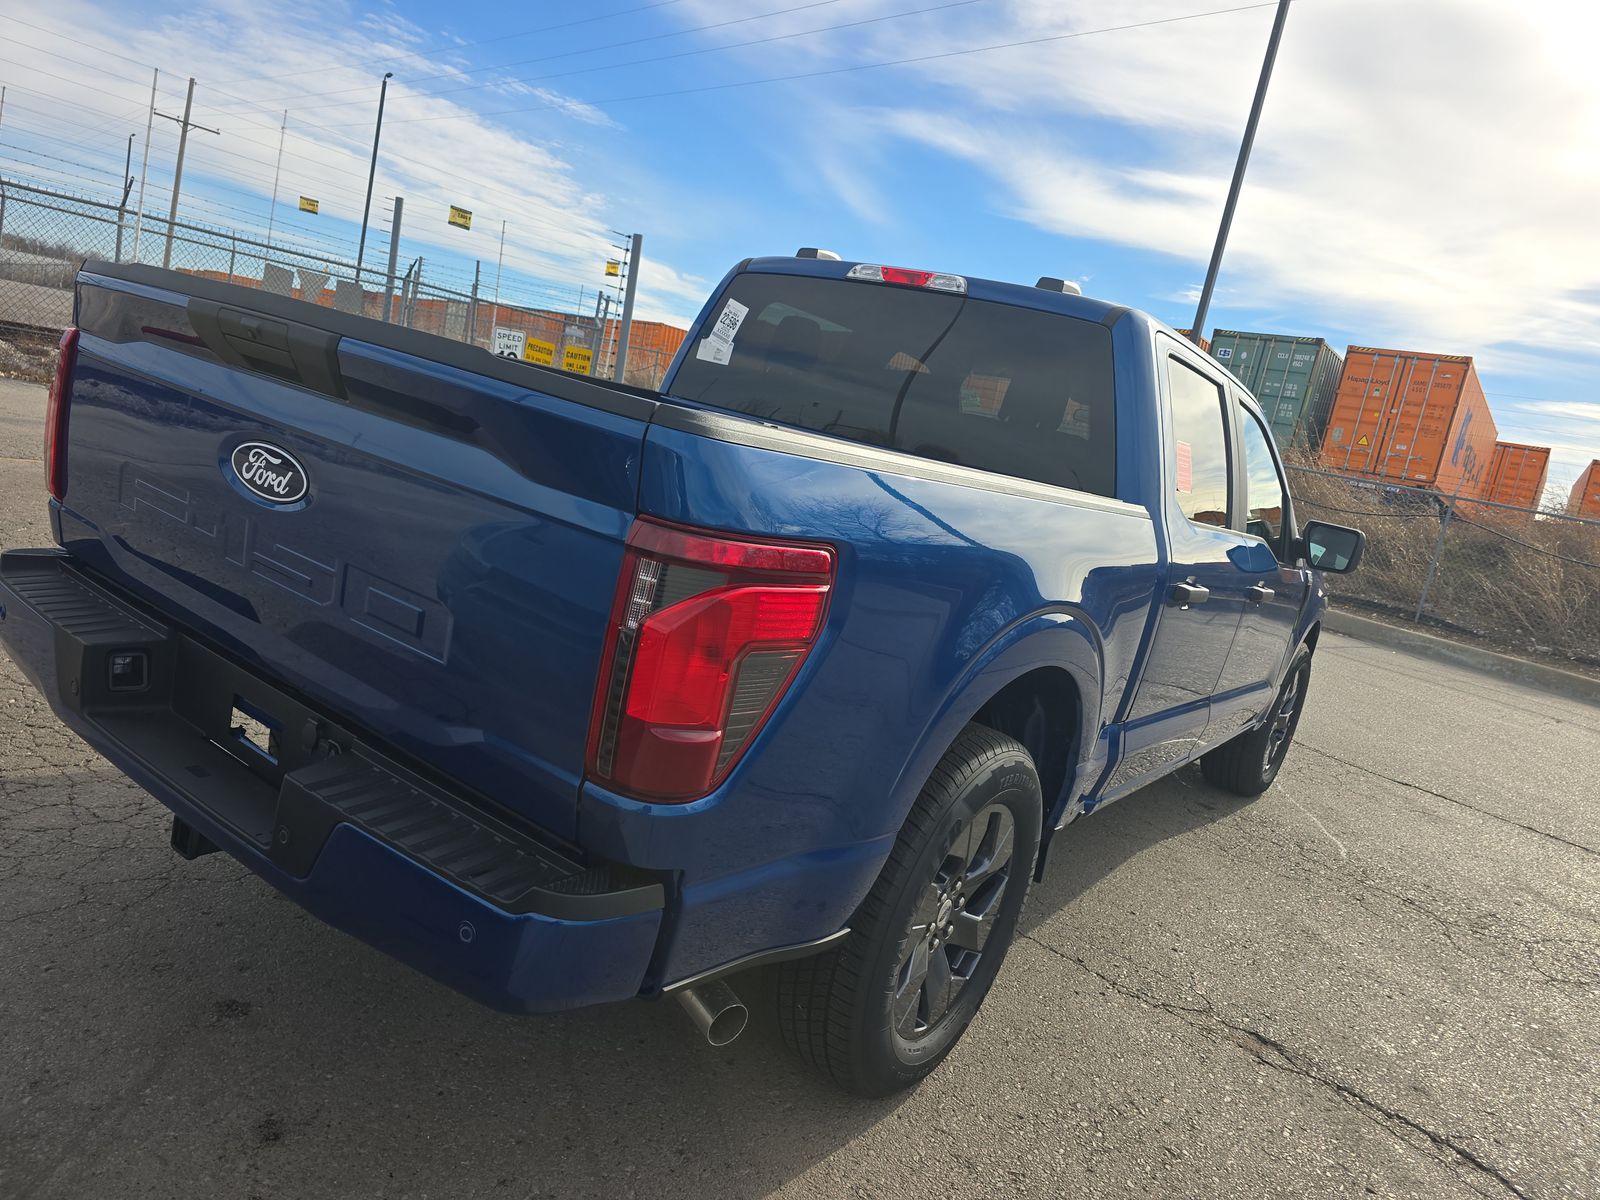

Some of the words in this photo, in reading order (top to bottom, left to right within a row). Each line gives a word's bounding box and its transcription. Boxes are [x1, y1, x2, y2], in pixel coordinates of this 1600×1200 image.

[497, 332, 523, 343] SPEED
[498, 343, 518, 352] LIMIT
[565, 351, 591, 361] CAUTION
[242, 448, 293, 495] Ford
